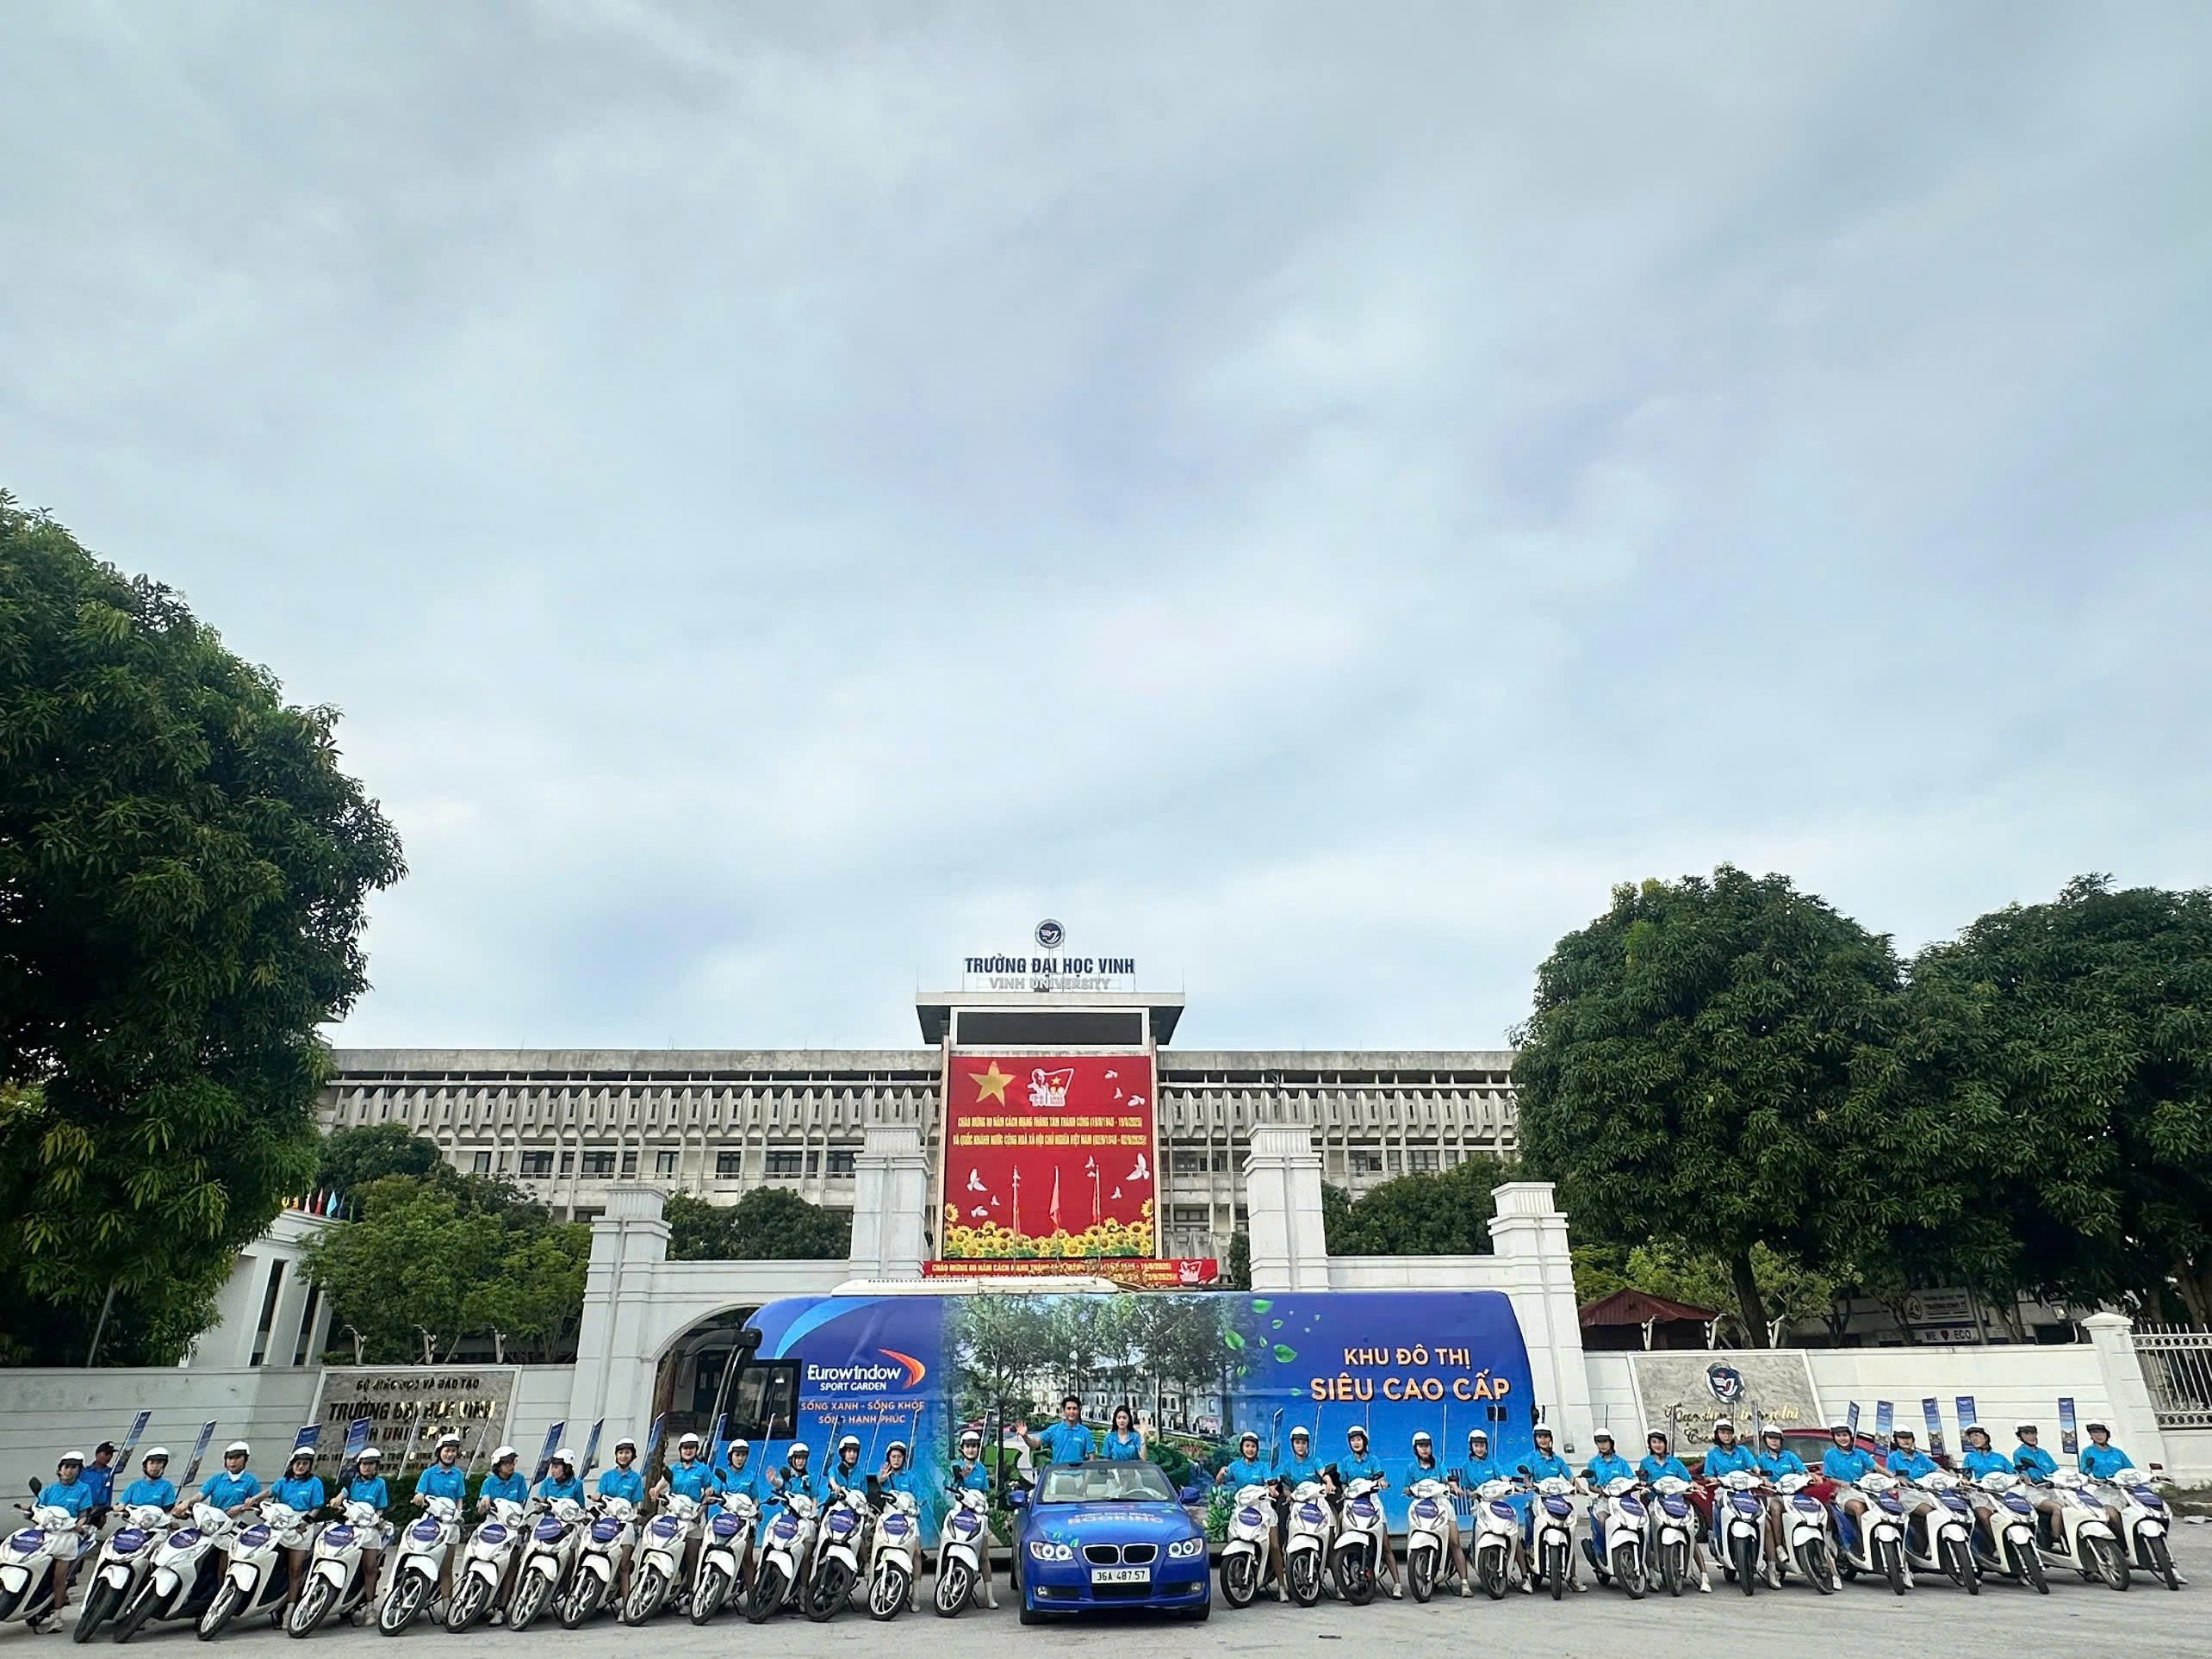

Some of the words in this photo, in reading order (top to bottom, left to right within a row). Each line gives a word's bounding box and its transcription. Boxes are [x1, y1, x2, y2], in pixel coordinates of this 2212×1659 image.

[965, 953, 1026, 973] TRƯỜNG
[1031, 957, 1057, 978] ĐẠI
[1063, 957, 1093, 978] HỌC
[1098, 957, 1134, 974] VINH
[990, 977, 1025, 990] VINH
[1029, 977, 1111, 990] UNIVERSITY
[1954, 1329, 1971, 1339] ECO
[1344, 1347, 1389, 1366] KHU
[1395, 1343, 1429, 1366] ĐÔ
[1434, 1347, 1470, 1369] THỊ
[423, 1377, 435, 1389] VÀ
[461, 1378, 479, 1391] TẠO
[820, 1382, 849, 1391] SPORT
[850, 1382, 887, 1391] GARDEN
[1310, 1371, 1374, 1401] SIÊU
[1382, 1377, 1444, 1401] CAO
[1453, 1369, 1510, 1401] CẤP
[329, 1397, 390, 1420] TRƯỜNG
[801, 1399, 829, 1411] SỐNG
[831, 1401, 859, 1410] XANH
[867, 1399, 896, 1411] SỐNG
[898, 1399, 925, 1411] KHỎE
[879, 1413, 906, 1424] PHÚC
[1097, 1571, 1112, 1581] 36A
